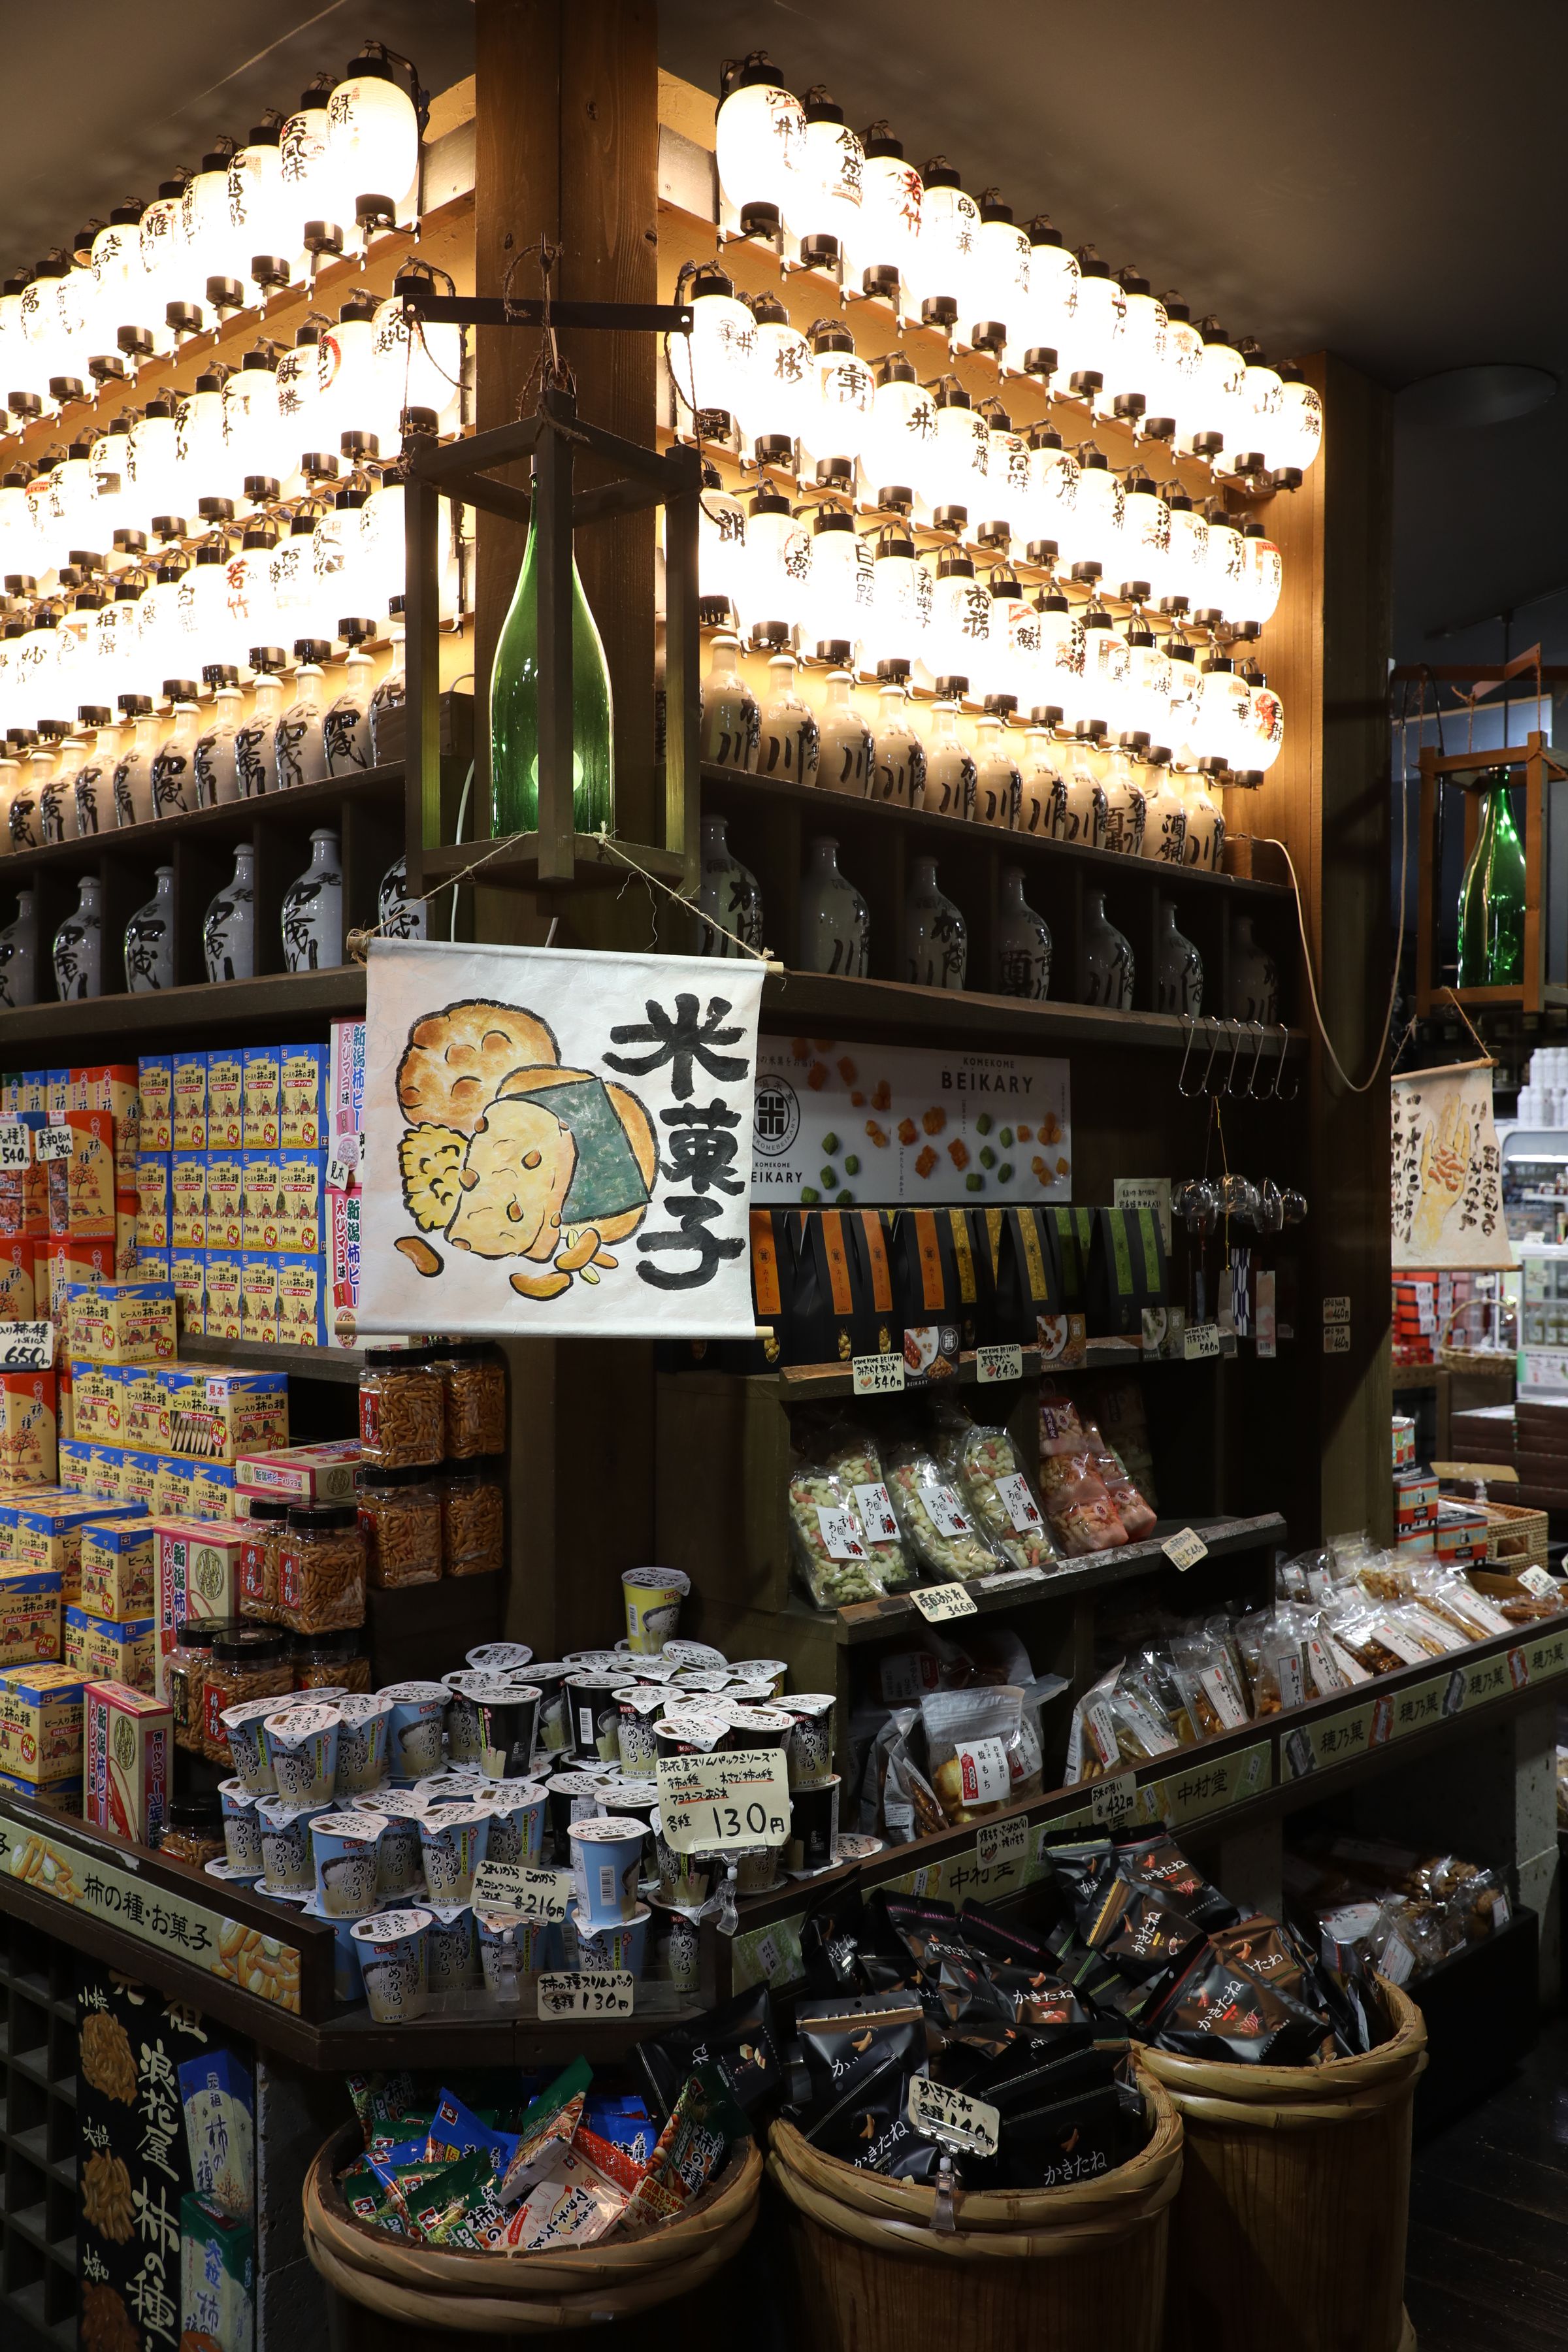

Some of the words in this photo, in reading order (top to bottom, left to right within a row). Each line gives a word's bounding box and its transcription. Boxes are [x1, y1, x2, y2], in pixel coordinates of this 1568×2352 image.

[963, 1057, 1015, 1069] KOMEKOME
[941, 1071, 1033, 1094] BEIKARY
[602, 992, 750, 1291] 米菓子
[3, 1147, 29, 1164] 540円
[330, 1161, 345, 1182] 見本
[5, 1347, 50, 1365] 650円
[1199, 1341, 1218, 1354] 540円
[874, 1375, 902, 1389] 540円
[996, 1365, 1019, 1379] 648円
[209, 1385, 224, 1397] 見本
[865, 1499, 874, 1526] あられ
[930, 1500, 943, 1525] あられ
[1006, 1490, 1018, 1518] あられ
[827, 1521, 837, 1546] あられ
[947, 1601, 975, 1616] 346円
[1321, 1720, 1364, 1753] 穂乃菓
[660, 1752, 777, 1772] 浪花屋スリムパックシリーズ
[977, 1751, 990, 1789] 焼もち
[1178, 1768, 1228, 1807] 中村堂
[666, 1815, 691, 1831] 各種
[713, 1803, 785, 1838] 130円
[1140, 1861, 1188, 1882] かきたね
[84, 1872, 212, 1951] 柿の種・お菓子
[523, 1894, 564, 1917] 216円
[1132, 1912, 1162, 1955] かきたね
[541, 1974, 633, 1993] 柿の種スリムパック
[551, 1995, 574, 2010] 各種
[582, 1991, 629, 2010] 130円
[1013, 1989, 1075, 2004] かきたね
[1198, 1980, 1244, 2032] かきたね
[918, 2079, 972, 2113] かきたね
[135, 2038, 179, 2181] 浪花屋
[679, 2125, 714, 2193] 柿の種
[1044, 2151, 1107, 2185] かきたね
[126, 2176, 180, 2346] 柿の種
